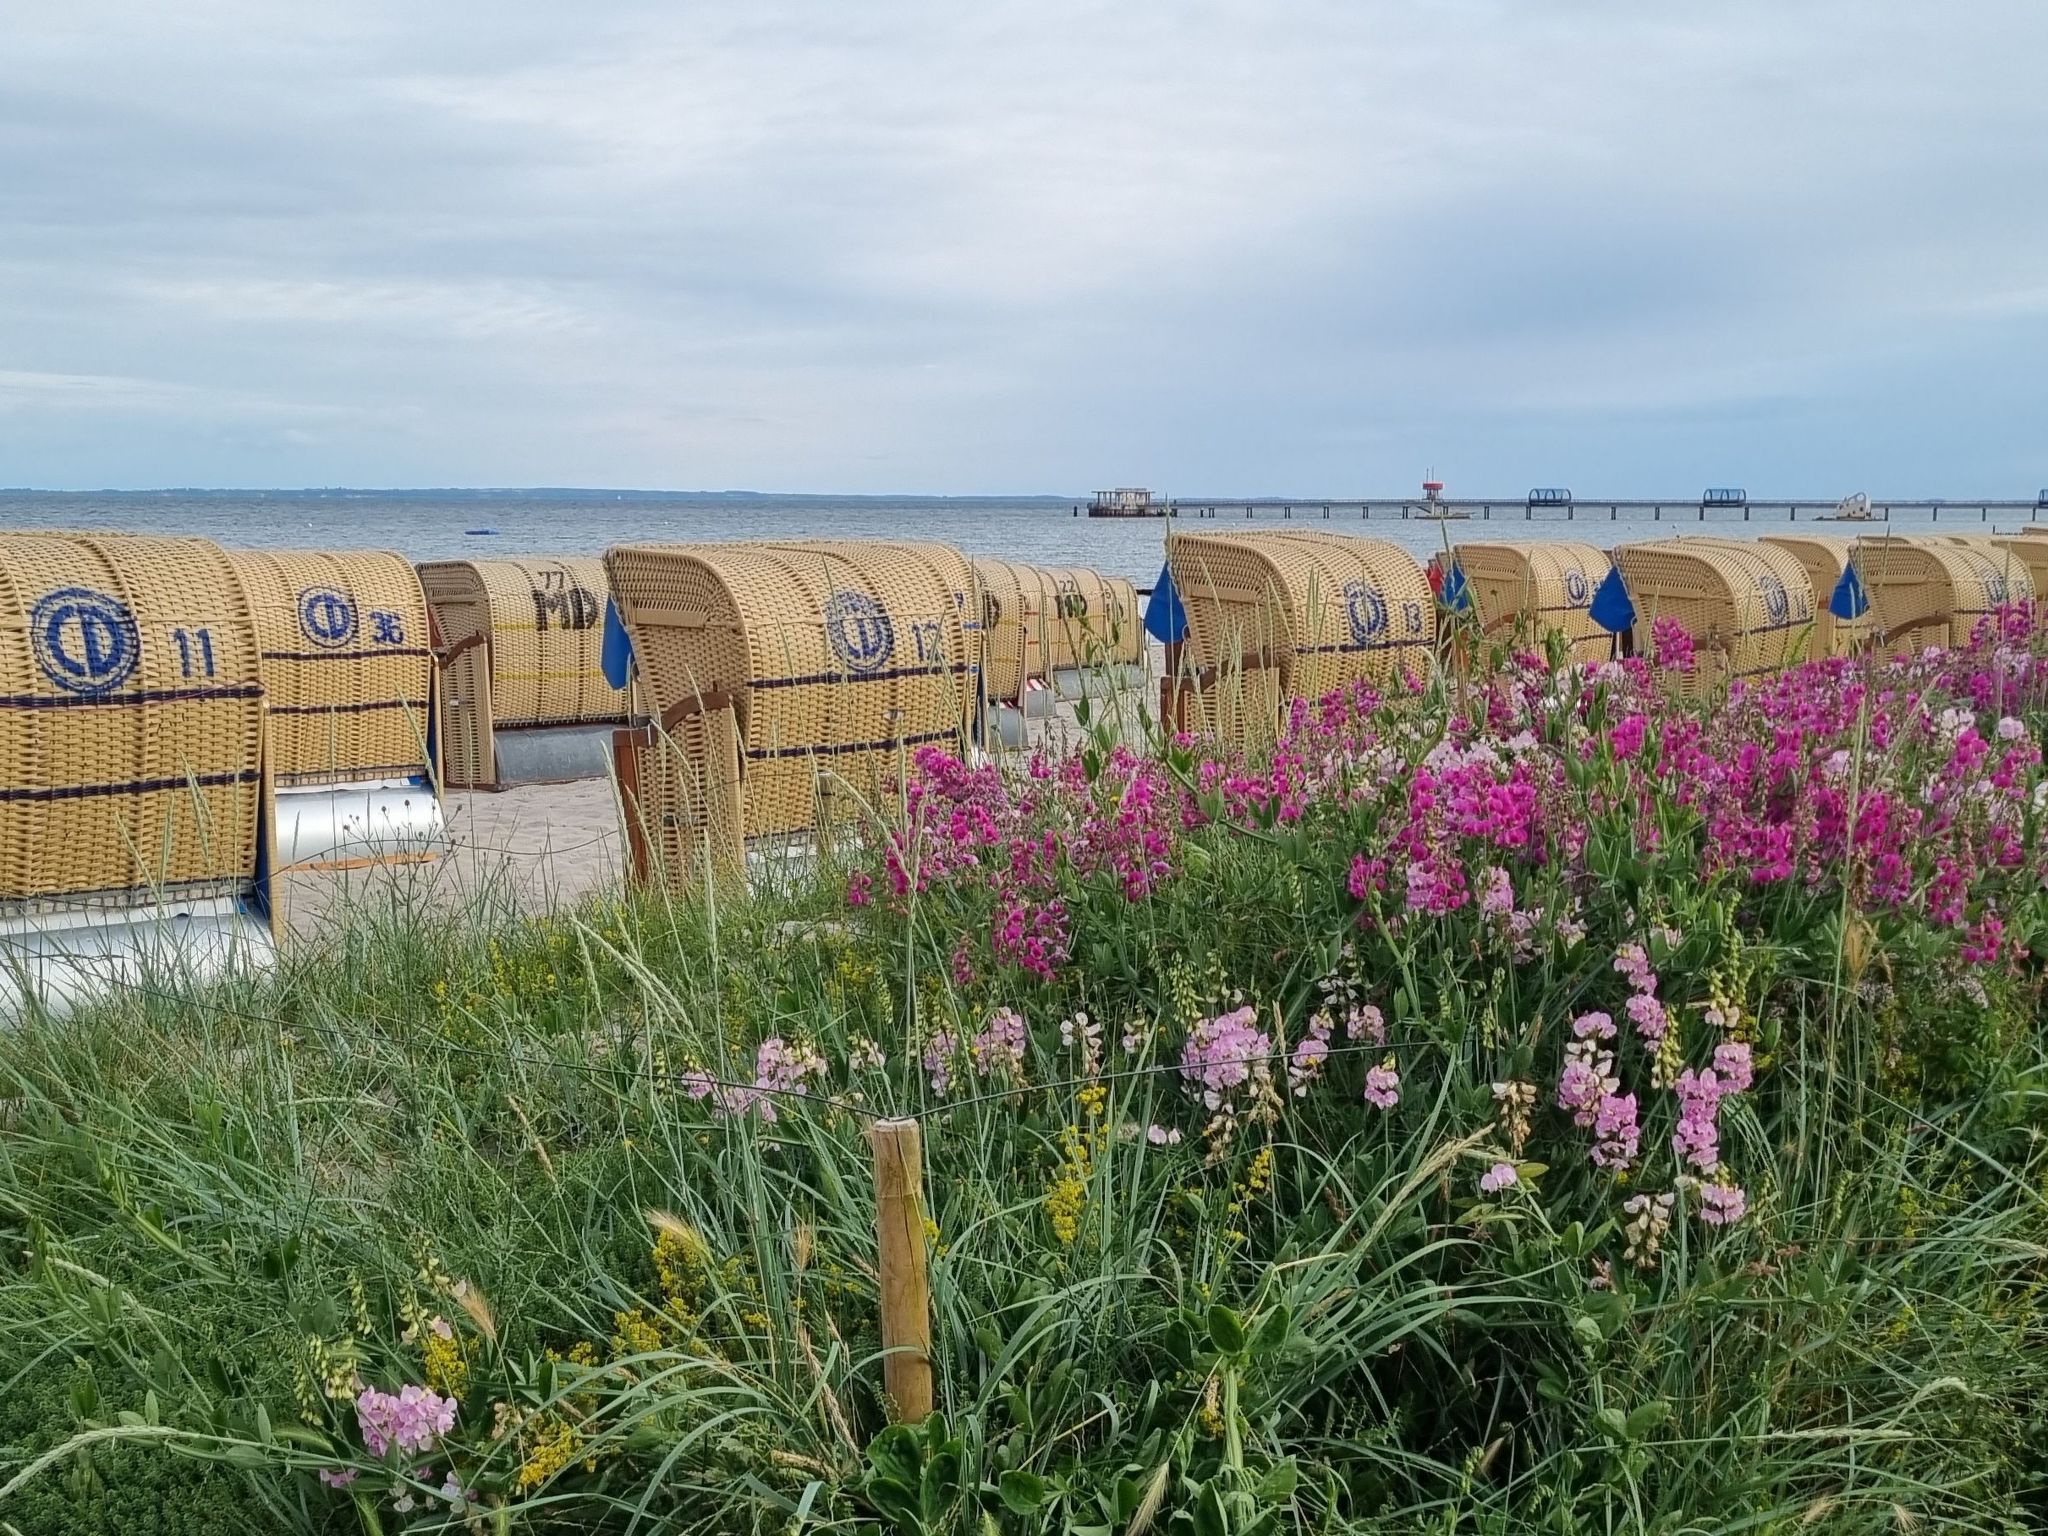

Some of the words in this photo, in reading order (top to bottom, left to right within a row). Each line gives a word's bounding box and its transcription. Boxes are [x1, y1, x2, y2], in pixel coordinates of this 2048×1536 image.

[537, 571, 564, 589] 77
[369, 611, 404, 644] 36
[532, 588, 598, 631] MD
[173, 628, 214, 678] 11
